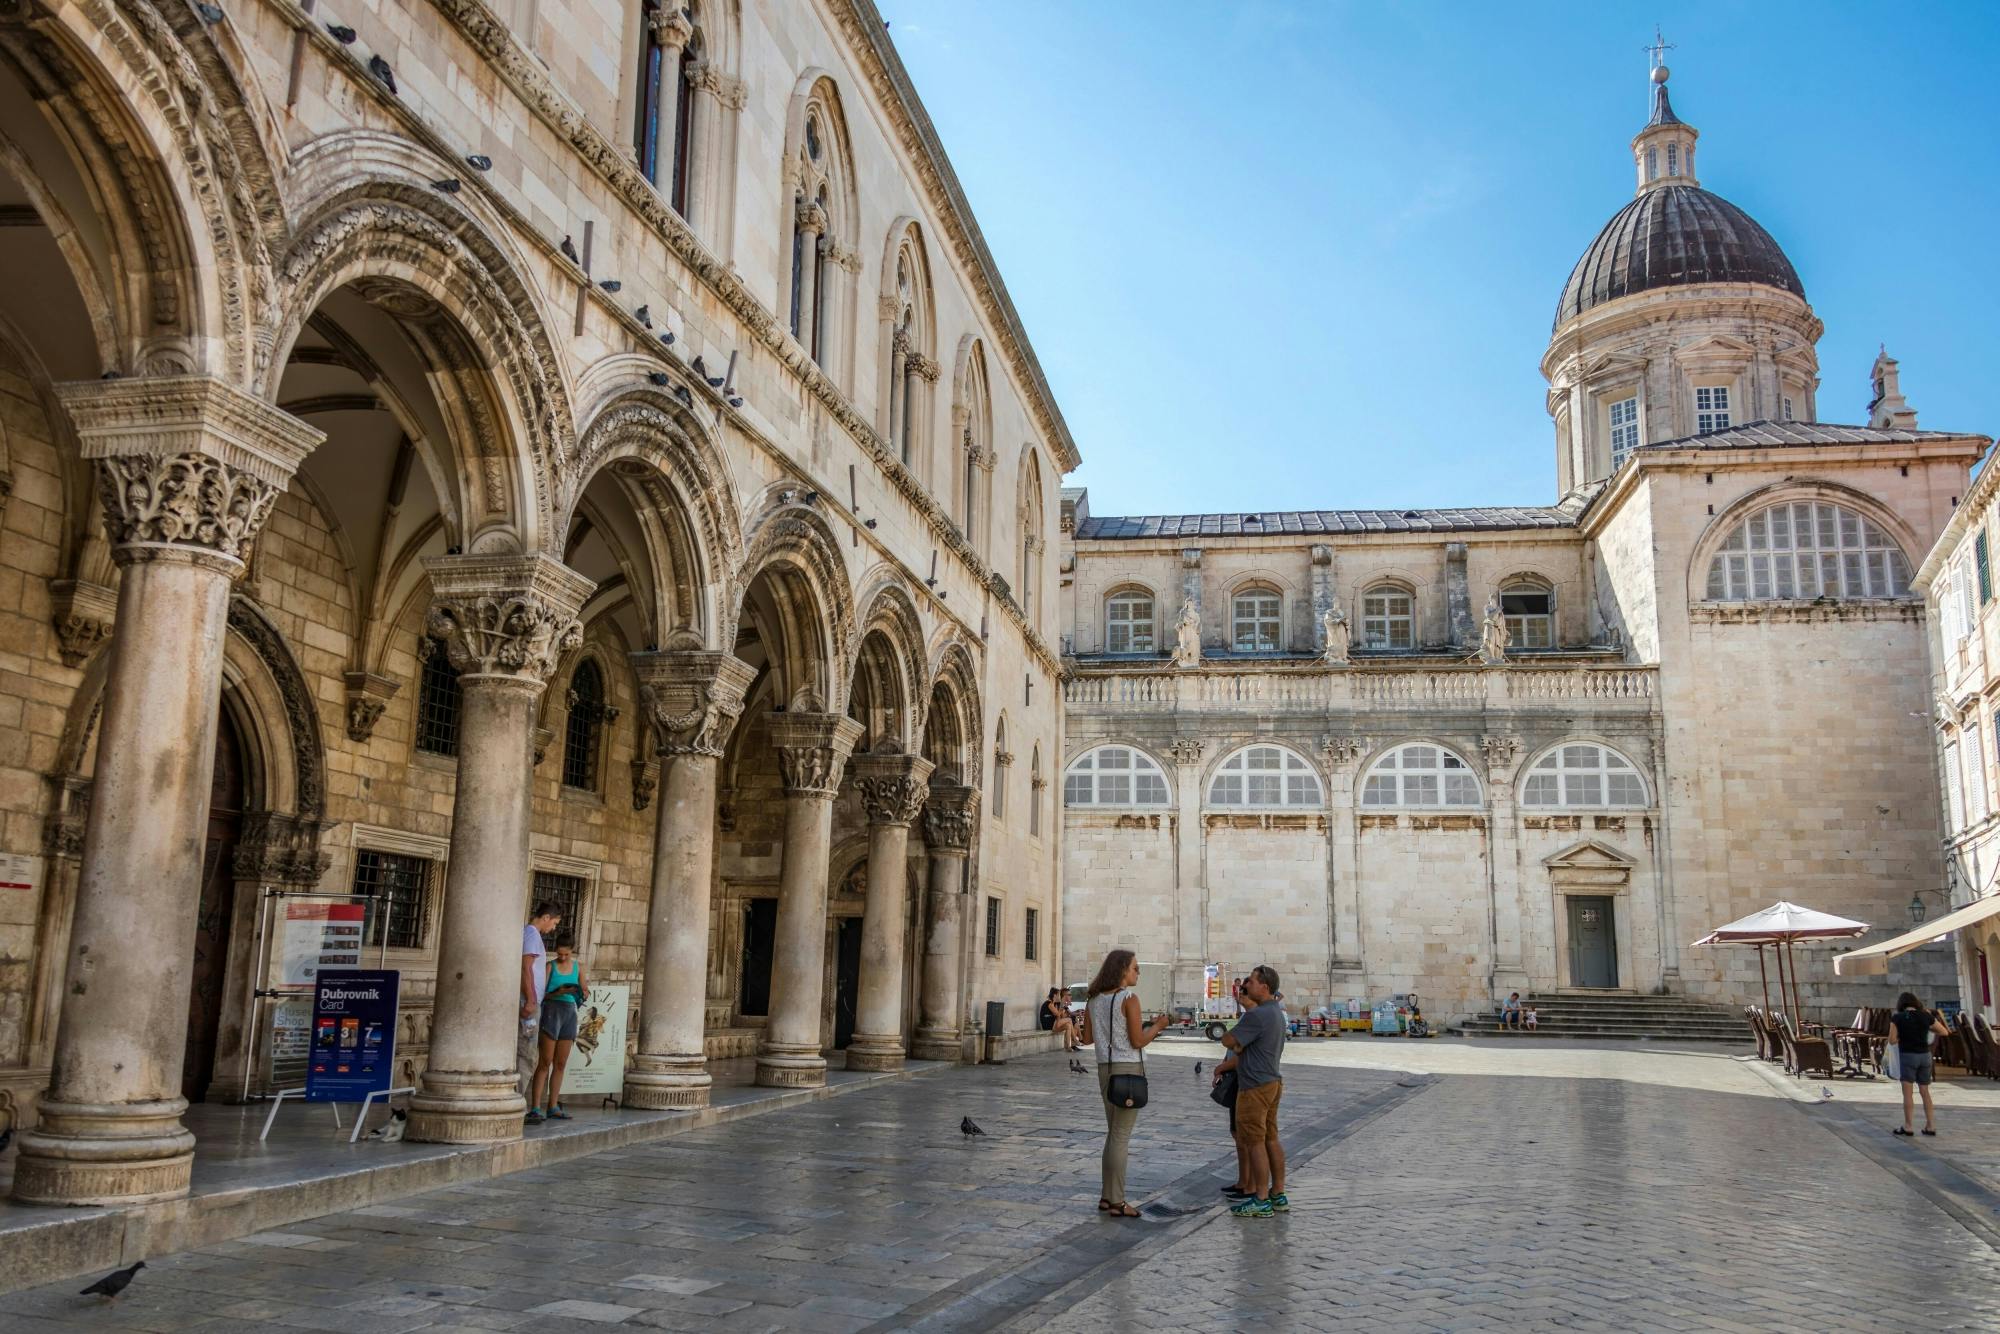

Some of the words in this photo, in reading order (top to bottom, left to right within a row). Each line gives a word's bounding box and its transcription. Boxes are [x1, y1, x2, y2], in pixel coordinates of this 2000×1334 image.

[321, 989, 380, 999] Dubrovnik
[320, 999, 344, 1010] Card
[317, 1027, 324, 1038] 1
[341, 1027, 349, 1038] 3
[365, 1027, 373, 1038] 7
